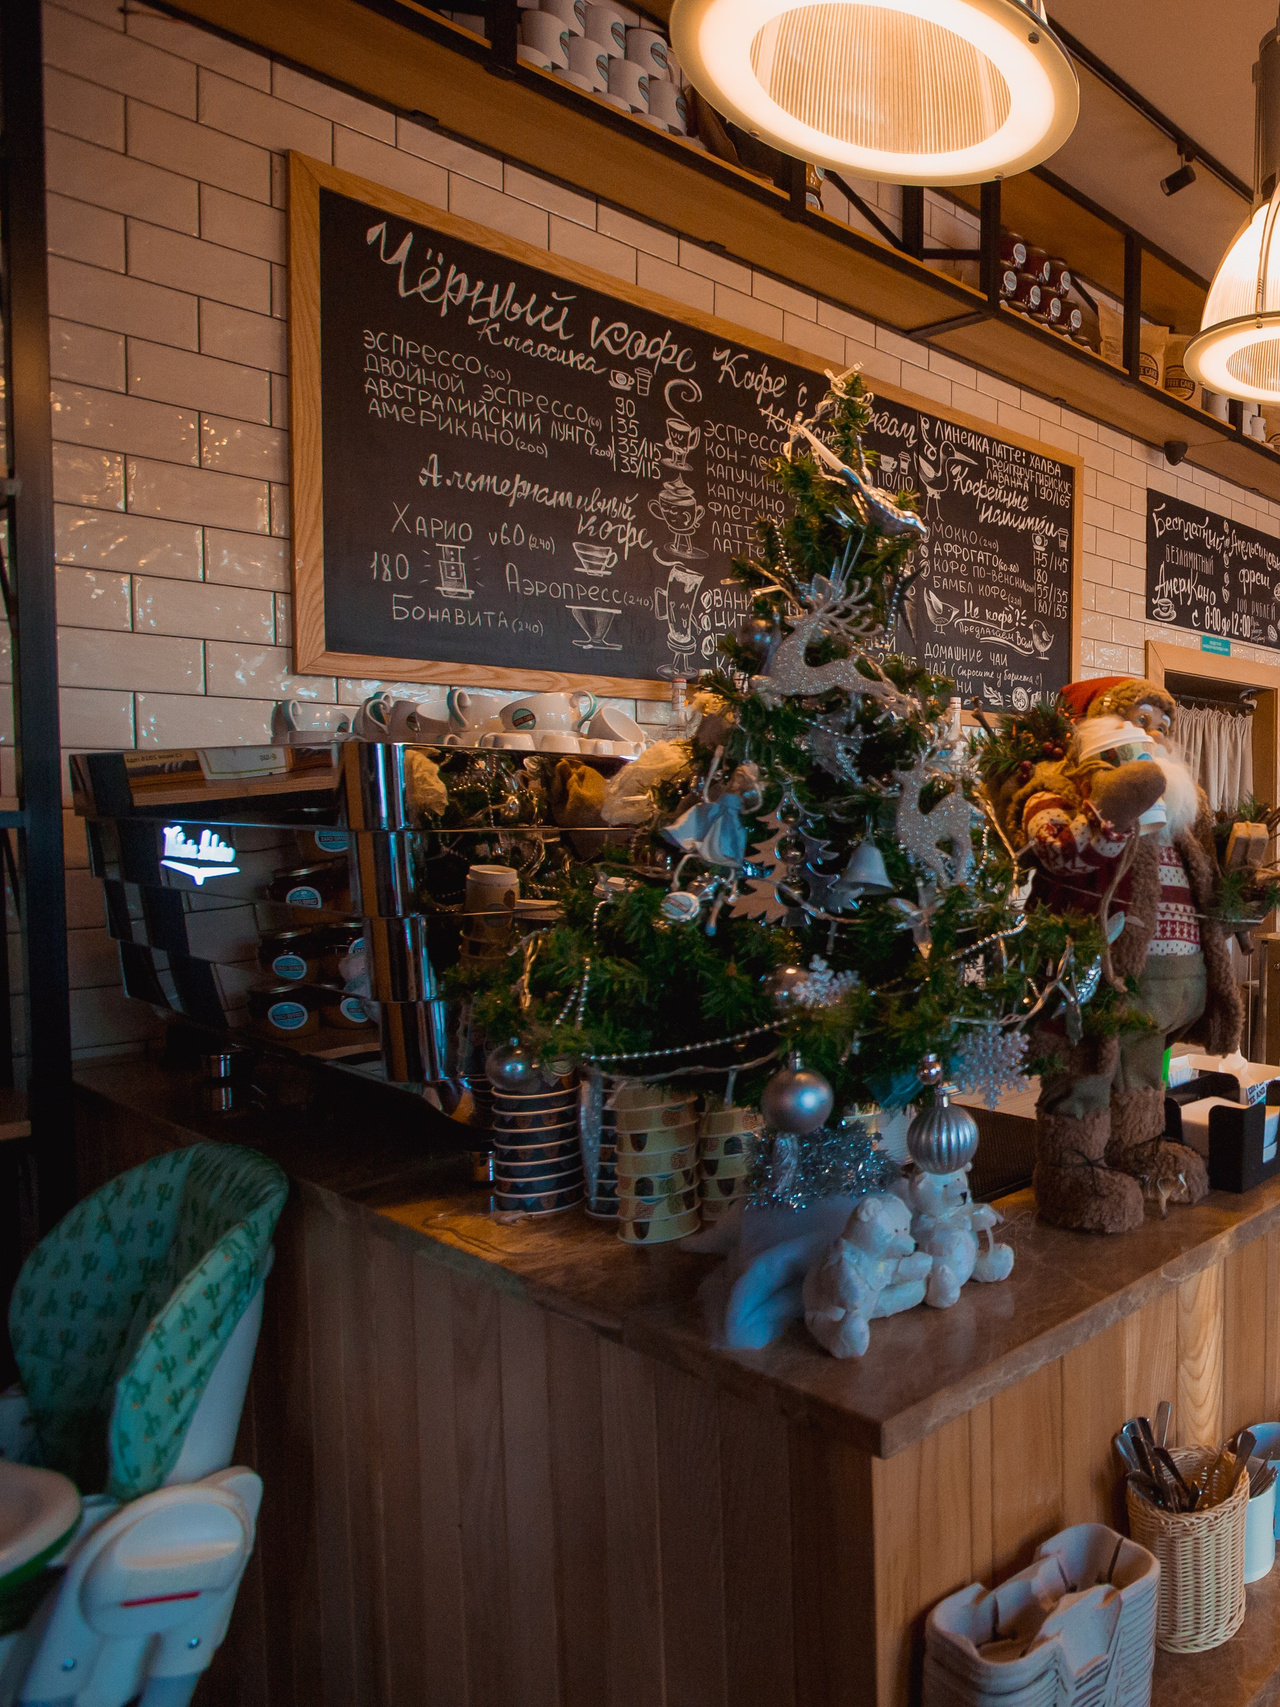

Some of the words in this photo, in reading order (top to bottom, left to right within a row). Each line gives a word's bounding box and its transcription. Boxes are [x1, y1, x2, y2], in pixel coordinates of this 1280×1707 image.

[364, 353, 465, 395] ДВОЙНОЙ
[364, 377, 542, 435] АВСТРАЛИЙСКИЙ
[551, 420, 596, 446] ЛУНГО
[615, 396, 636, 418] 90
[611, 415, 640, 438] 135
[1029, 454, 1061, 478] ХАЛВА
[706, 481, 785, 514] КАПУЧИНО
[931, 521, 978, 545] МОККО
[370, 551, 410, 582] 180
[934, 541, 999, 568] АФФОГАТО
